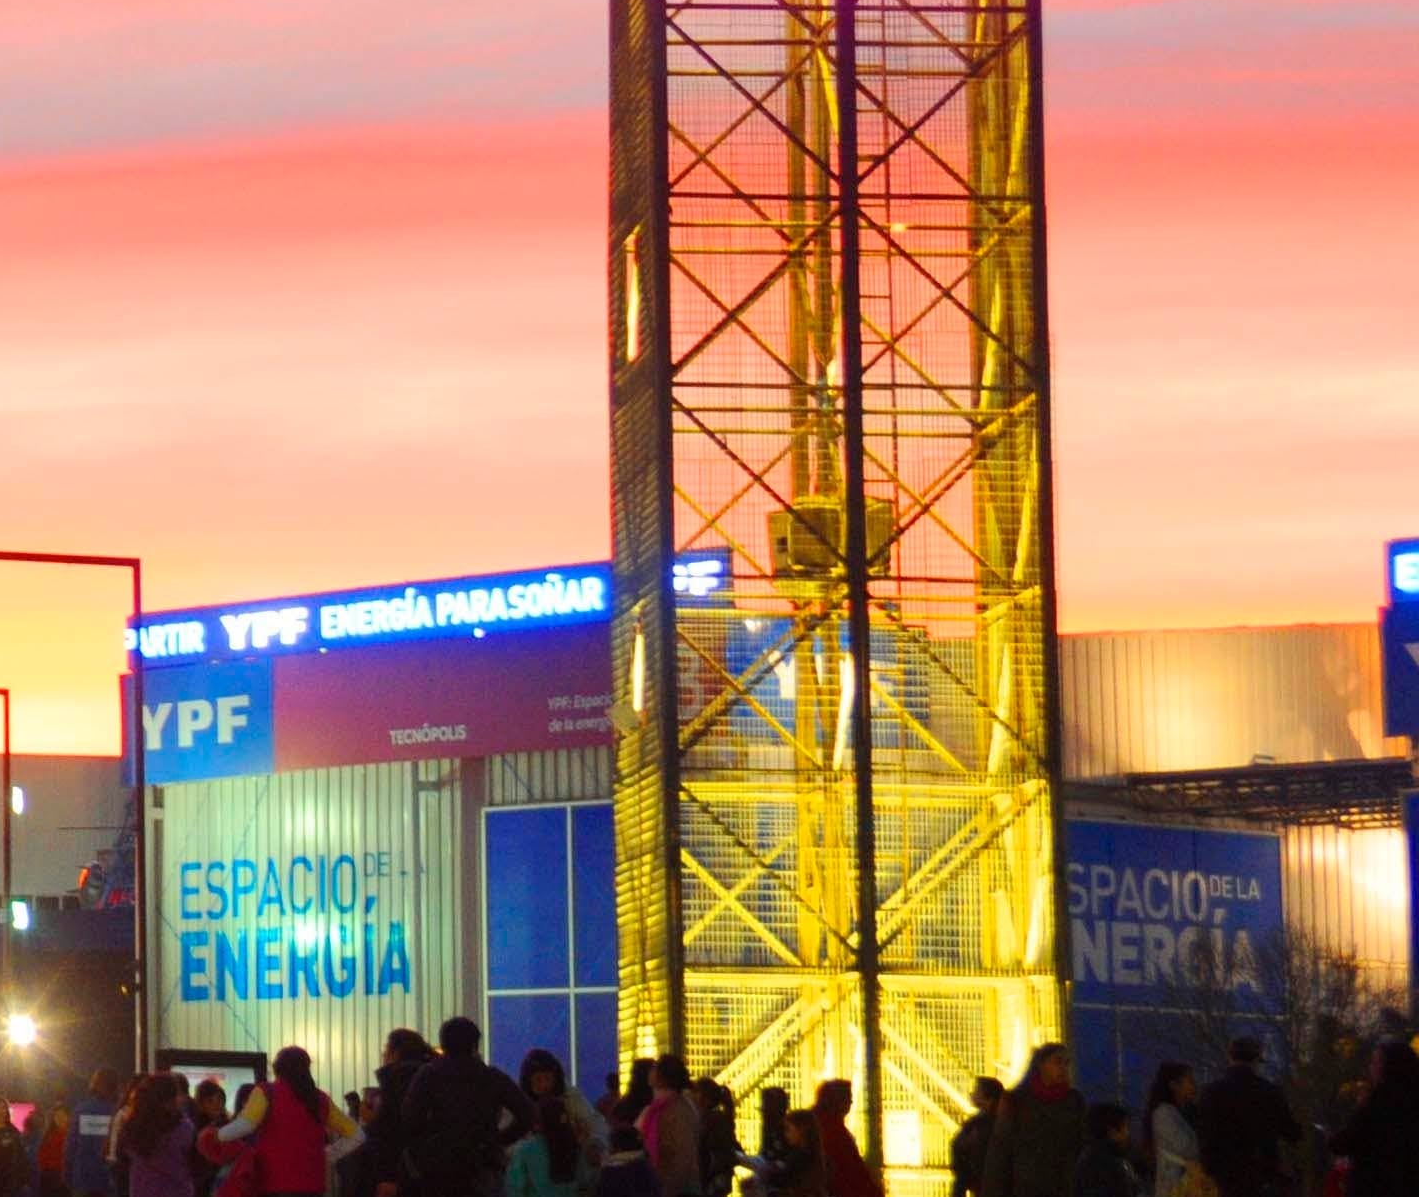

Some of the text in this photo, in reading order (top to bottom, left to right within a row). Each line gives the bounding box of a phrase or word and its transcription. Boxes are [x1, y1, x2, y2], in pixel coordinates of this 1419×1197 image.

[219, 606, 309, 651] YPF
[320, 587, 435, 639] ENERGÍA
[142, 694, 250, 751] YPF
[389, 723, 467, 745] TECNÓPOLIS
[181, 855, 357, 920] ESPACIO
[1067, 863, 1260, 922] SPACIO DE LA
[181, 896, 411, 1002] ENERGÍA
[1070, 908, 1262, 991] NERGÍA
